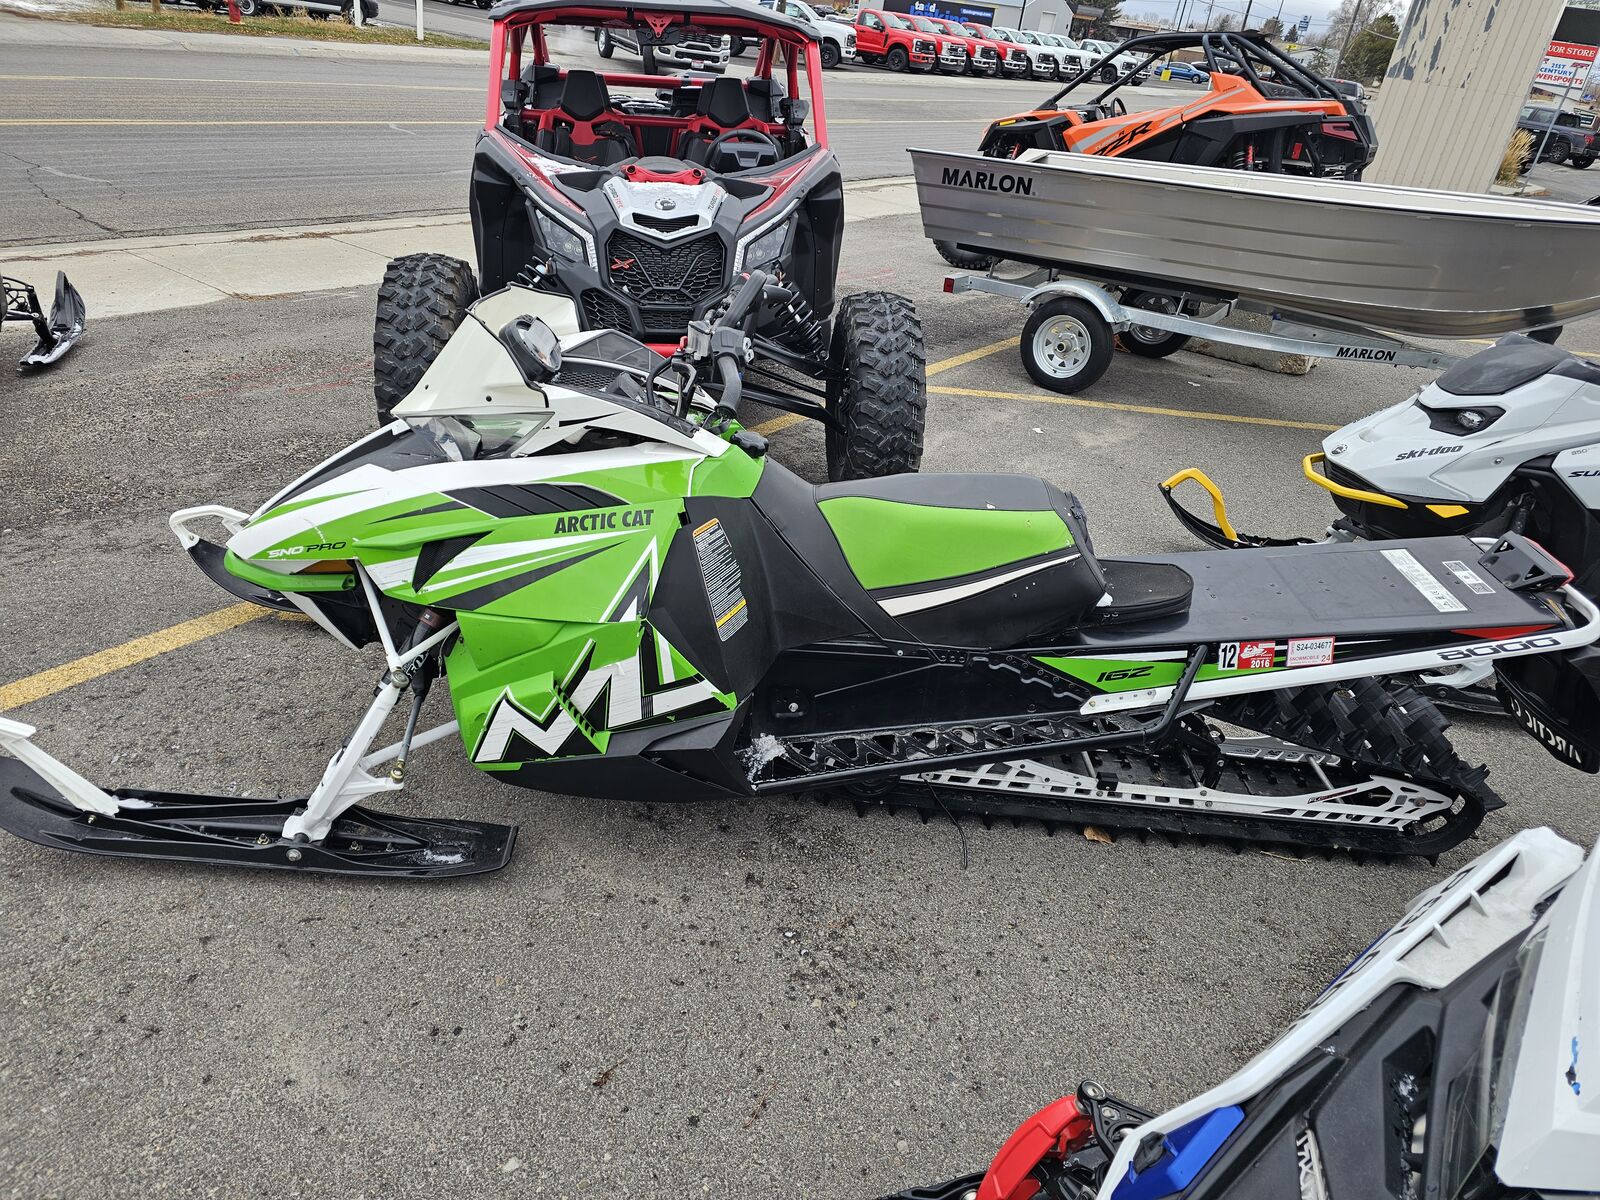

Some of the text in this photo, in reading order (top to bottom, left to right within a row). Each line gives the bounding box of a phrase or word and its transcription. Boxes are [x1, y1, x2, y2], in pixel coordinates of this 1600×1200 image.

[1566, 47, 1596, 57] STORE
[1540, 67, 1573, 76] CENTURY
[941, 167, 1033, 196] MARLON
[1336, 347, 1397, 361] MARLON
[1395, 445, 1463, 460] ski-doo
[554, 509, 654, 534] ARCTIC CAT
[1296, 641, 1332, 651] S24-034677
[1436, 636, 1561, 661] 8000
[1220, 643, 1237, 668] 12
[1321, 654, 1331, 662] 24
[1250, 660, 1272, 668] 2016
[1097, 665, 1154, 683] 162
